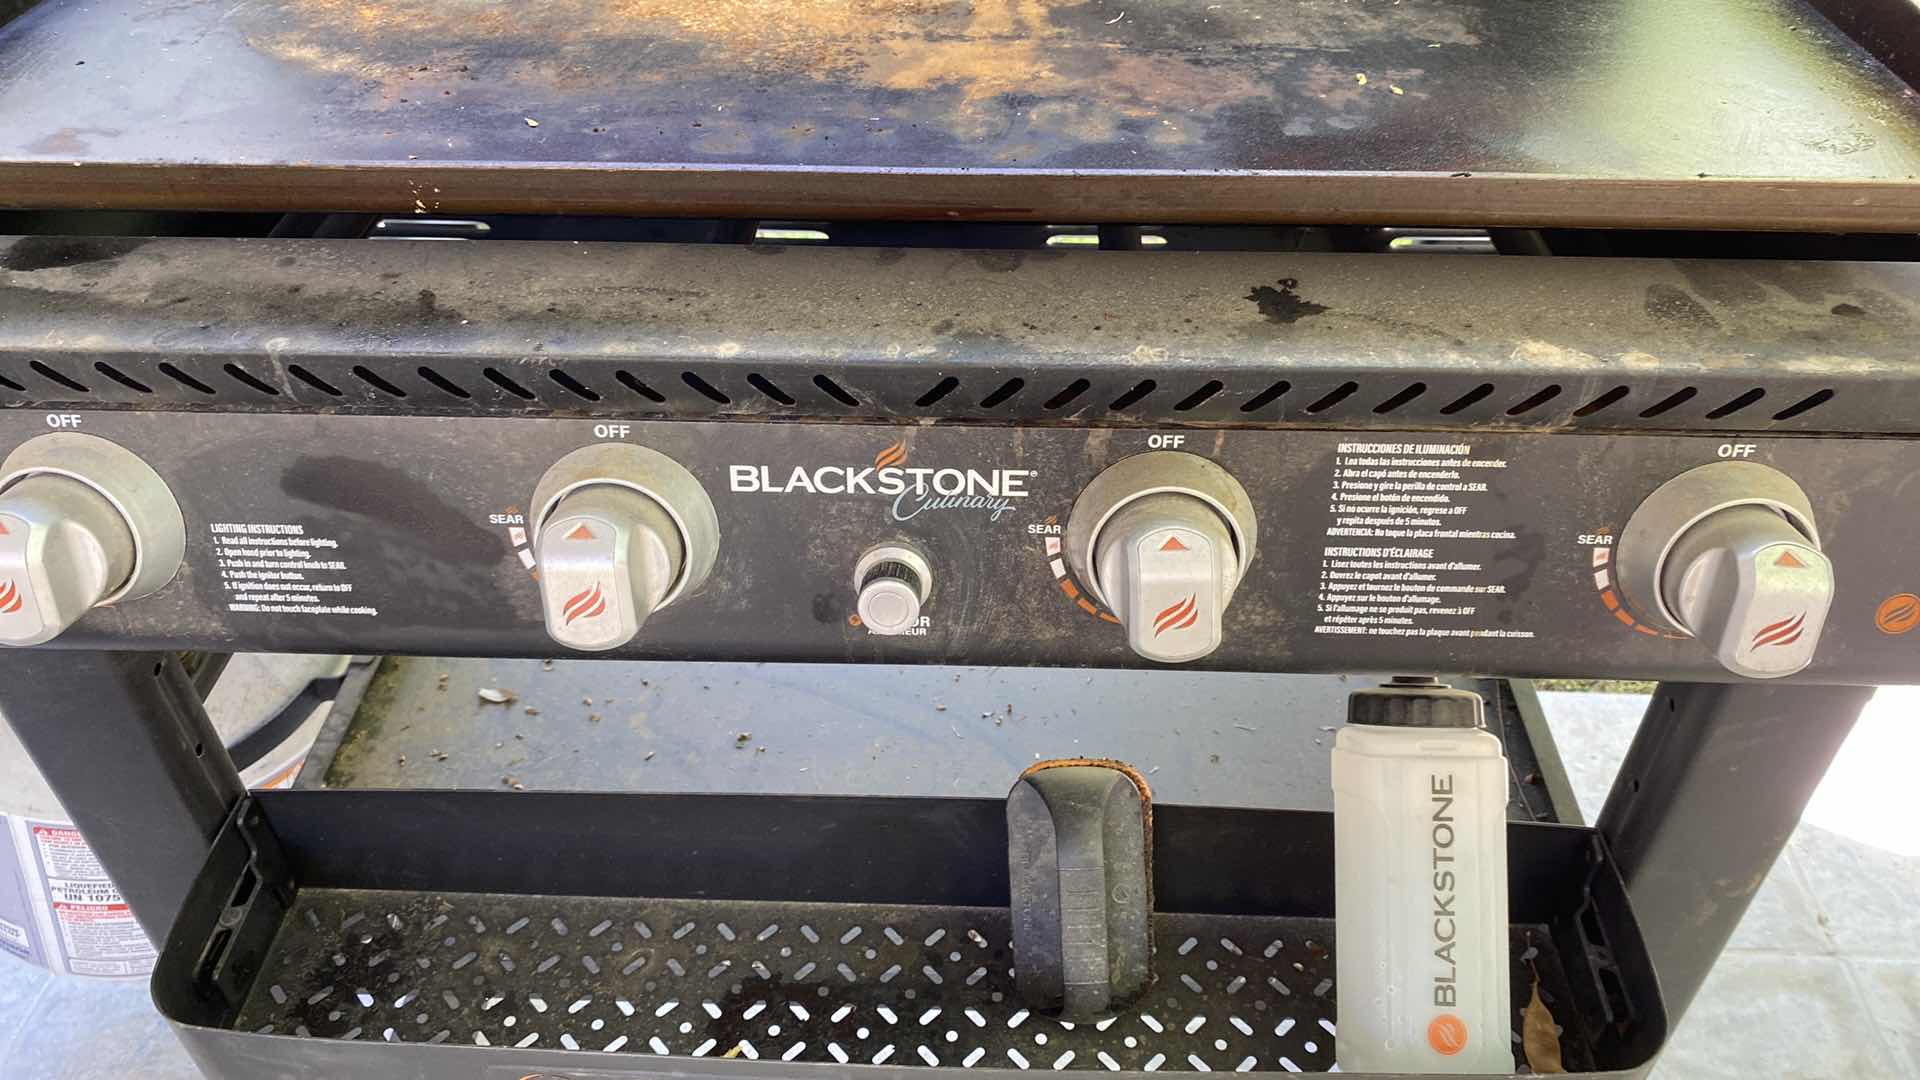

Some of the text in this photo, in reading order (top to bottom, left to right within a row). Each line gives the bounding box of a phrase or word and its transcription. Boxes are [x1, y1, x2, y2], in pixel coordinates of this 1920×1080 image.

[46, 414, 82, 428] OFF
[593, 424, 630, 439] OFF
[1147, 434, 1185, 449] OFF
[1337, 443, 1471, 454] INSTRUCCIONES DE ILUMINACIÓN
[1717, 443, 1757, 458] OFF
[1345, 457, 1507, 467] Lea todas las instrucciones antes de encender.
[1343, 469, 1360, 477] Abra
[1387, 470, 1408, 478] antes
[1408, 470, 1418, 478] de
[1418, 470, 1460, 479] encenderlo.
[1341, 481, 1488, 492] Presione gire perilla de control SEAR.
[892, 482, 1016, 521] Culinary
[1340, 493, 1450, 502] Presione botón de encendido.
[1388, 505, 1419, 515] ignición,
[1420, 507, 1448, 516] regrese
[1454, 506, 1468, 514] OFF
[488, 513, 524, 524] SEAR
[1342, 517, 1442, 527] repita después de minutos.
[210, 524, 304, 534] LIGHTING INSTRUCTIONS
[1027, 524, 1062, 534] SEAR
[1326, 528, 1375, 536] ADVERTENCIA:
[1385, 529, 1406, 539] toque
[1414, 529, 1433, 539] placa
[1434, 529, 1459, 537] frontal
[1459, 530, 1490, 538] mientras
[1491, 530, 1516, 538] cocina.
[221, 536, 239, 545] Read
[248, 537, 288, 545] instructions
[288, 537, 310, 546] before
[310, 538, 339, 548] lighting.
[1577, 535, 1613, 545] SEAR
[224, 548, 241, 558] Open
[241, 548, 259, 556] hood
[259, 548, 275, 558] prior
[283, 549, 311, 559] lighting.
[1324, 547, 1434, 558] INSTRUCTIONS D'ÉCLAIRAGE
[227, 559, 244, 567] Push
[252, 560, 264, 568] and
[264, 560, 280, 568] turn
[280, 560, 304, 568] control
[304, 561, 321, 569] knob
[328, 561, 347, 569] SEAR.
[1331, 560, 1482, 570] Lisez toutes les instructions avant d'allumer.
[247, 571, 258, 579] the
[1329, 571, 1354, 579] Ouvrez
[1362, 572, 1382, 582] capot
[1382, 572, 1403, 580] avant
[1403, 572, 1437, 580] d'allumer.
[238, 582, 263, 592] ignition
[263, 582, 280, 590] does
[292, 584, 312, 592] occur,
[312, 583, 333, 591] return
[1328, 583, 1357, 592] Appuyez
[1366, 583, 1393, 591] tournez
[1401, 584, 1426, 592] bouton
[1426, 584, 1436, 592] de
[1436, 584, 1474, 592] commande
[1487, 585, 1506, 593] SEAR.
[235, 592, 320, 603] and repeat after minutes.
[1326, 594, 1356, 603] Appuyez
[1376, 594, 1401, 602] bouton
[1401, 595, 1441, 605] d'allumage.
[261, 604, 270, 612] Do
[270, 604, 281, 612] not
[281, 605, 300, 613] touch
[301, 605, 331, 615] faceplate
[350, 606, 378, 616] cooking.
[1333, 604, 1368, 614] l'allumage
[1387, 605, 1413, 615] produit
[1413, 607, 1428, 615] pas,
[1332, 616, 1358, 625] répéter
[1358, 616, 1378, 626] après
[1314, 626, 1368, 634] AVERTISSEMENT:
[1378, 627, 1405, 635] touchez
[1405, 629, 1419, 637] pas
[1426, 628, 1450, 638] plaque
[1431, 774, 1457, 1008] BLACKSTONE
[64, 893, 82, 902] UN
